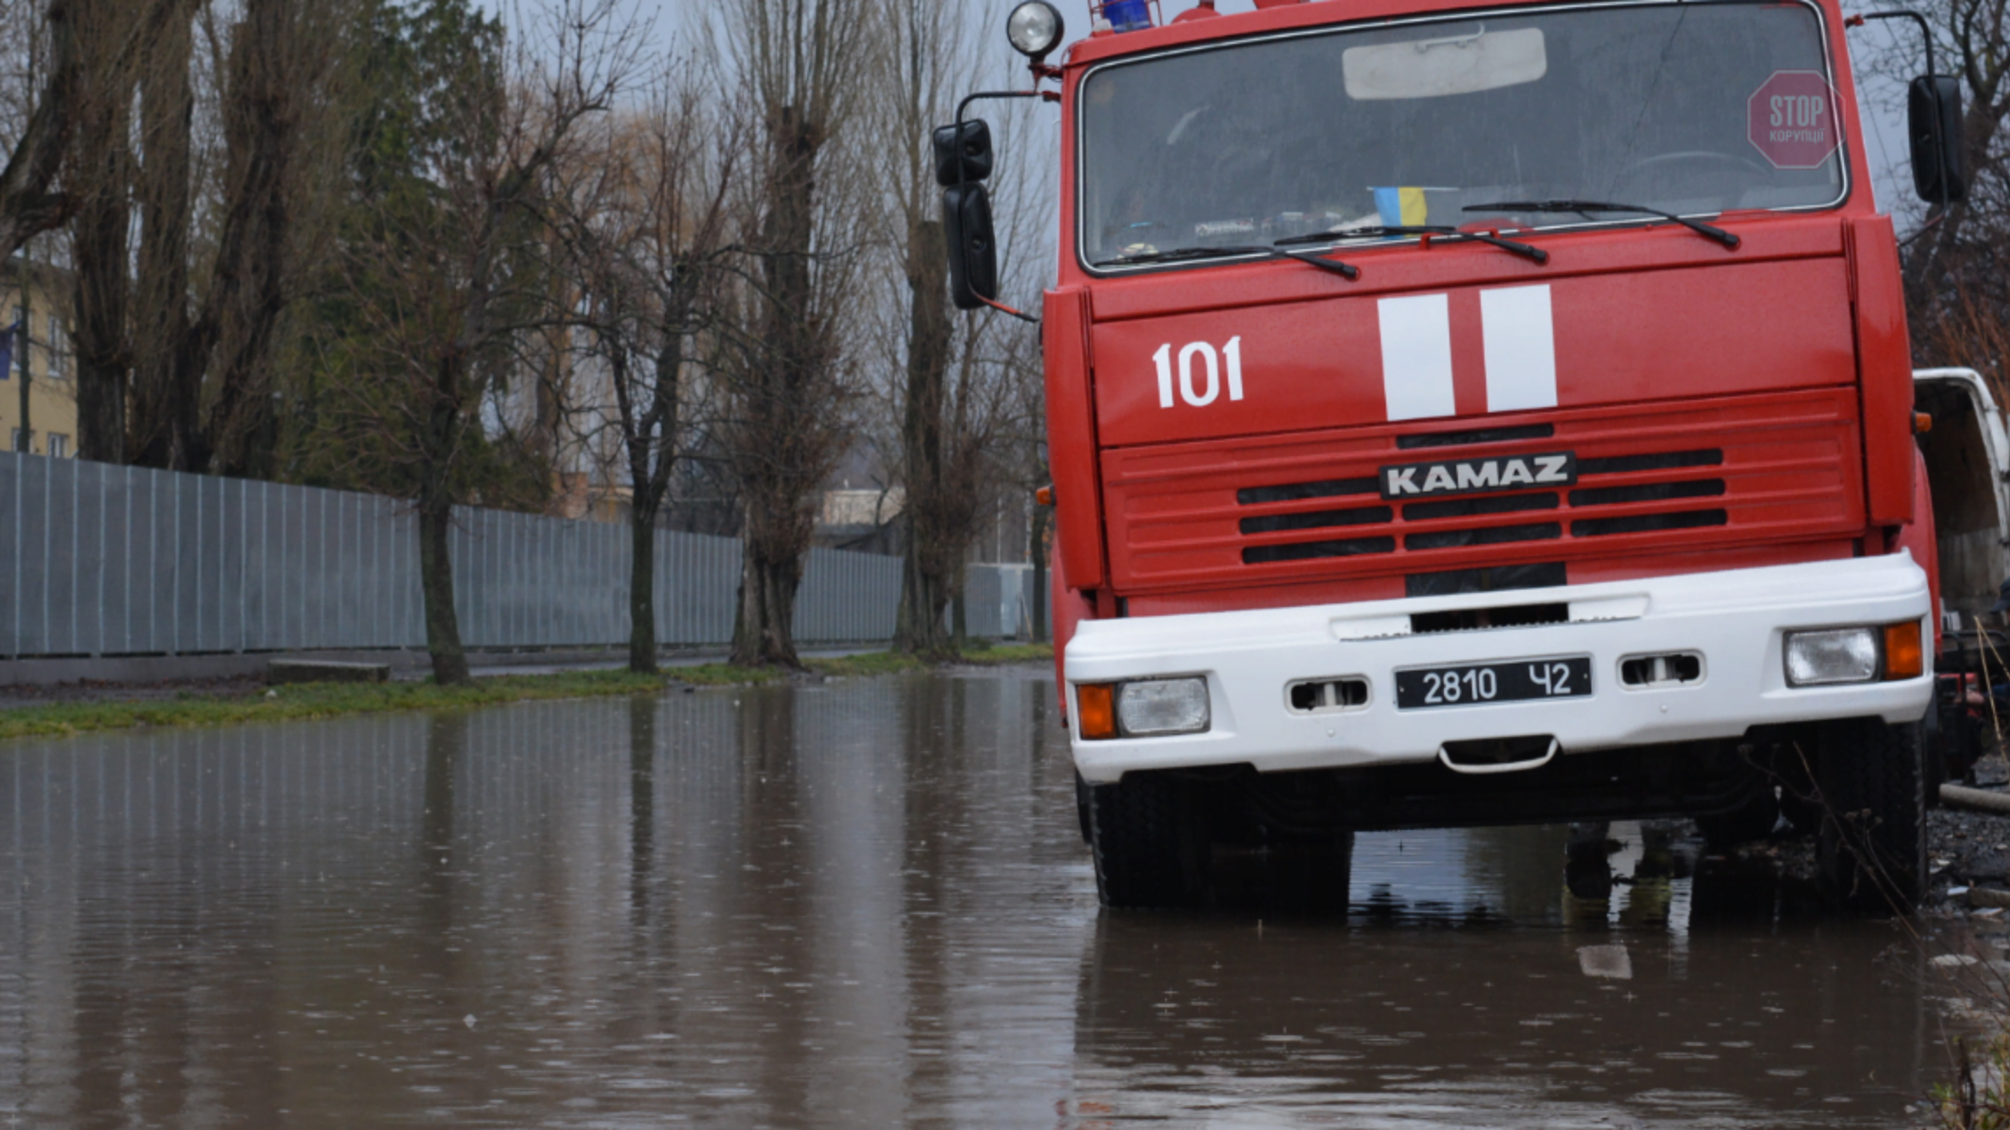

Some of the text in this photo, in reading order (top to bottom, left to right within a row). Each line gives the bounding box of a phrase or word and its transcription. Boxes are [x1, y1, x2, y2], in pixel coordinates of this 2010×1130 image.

[1152, 335, 1244, 409] 101
[1387, 455, 1568, 495] KAMAZ
[1423, 668, 1497, 703] 2810
